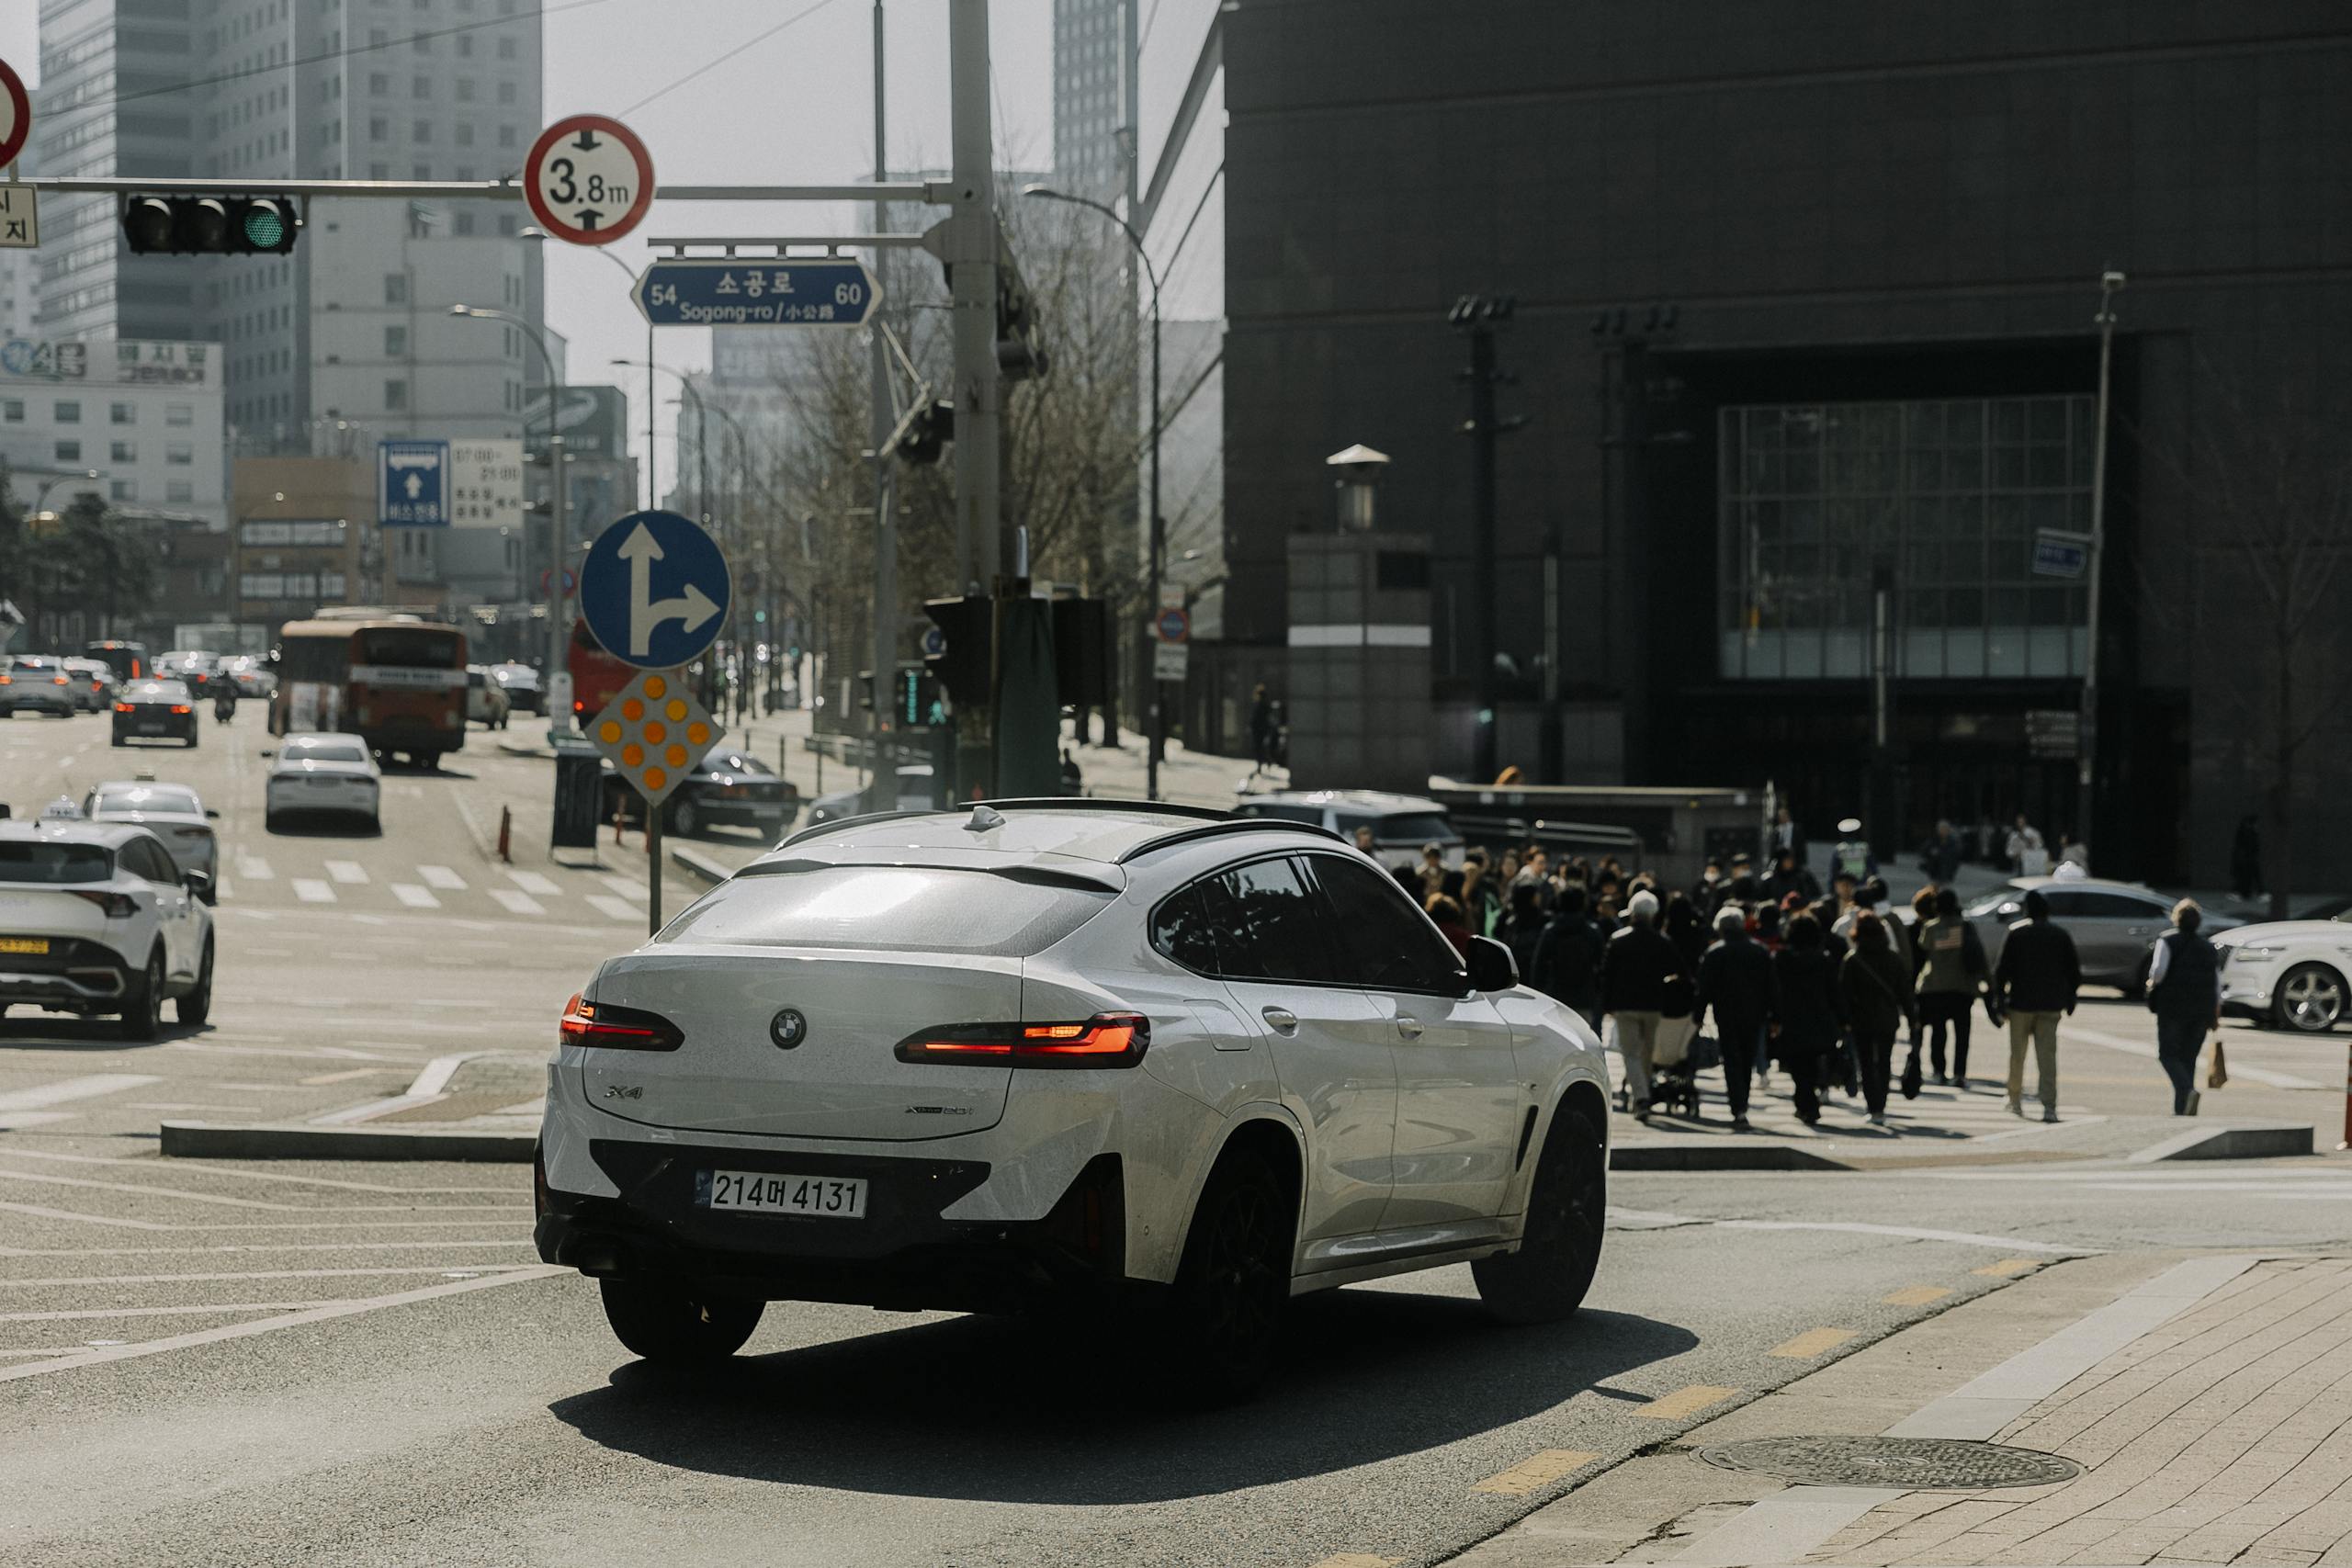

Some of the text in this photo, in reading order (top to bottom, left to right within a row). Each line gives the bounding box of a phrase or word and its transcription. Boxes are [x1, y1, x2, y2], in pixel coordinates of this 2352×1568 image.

[549, 157, 628, 204] 3.8m
[650, 284, 677, 306] 54
[716, 271, 795, 298] 소공로
[834, 283, 862, 305] 60
[603, 1085, 643, 1100] X4
[714, 1175, 857, 1213] 214머 4131
